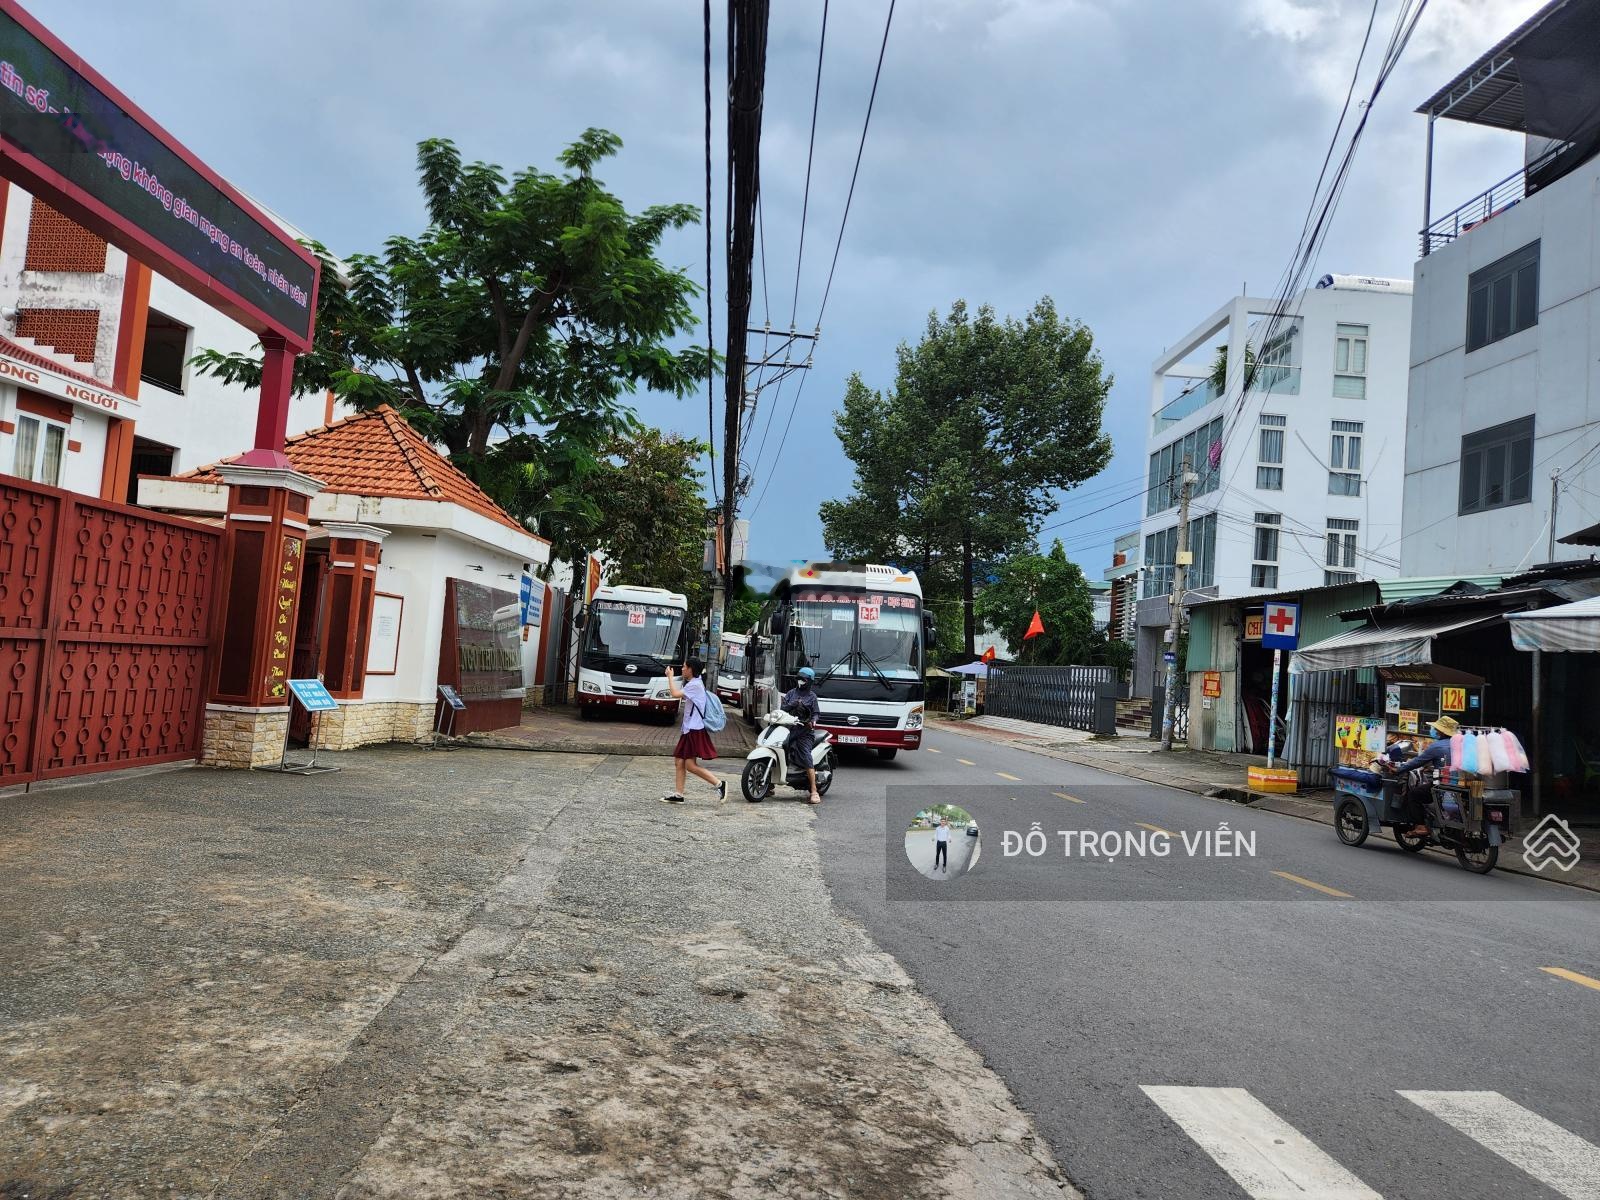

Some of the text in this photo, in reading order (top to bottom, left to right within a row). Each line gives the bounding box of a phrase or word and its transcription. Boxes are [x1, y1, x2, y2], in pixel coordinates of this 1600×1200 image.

[0, 61, 23, 97] tin
[25, 85, 50, 113] số
[133, 161, 174, 212] không
[173, 198, 199, 228] gian
[199, 216, 230, 254] mạng
[229, 240, 243, 261] an
[243, 247, 268, 282] toàn,
[267, 267, 290, 295] nhân
[1443, 688, 1464, 710] 12k
